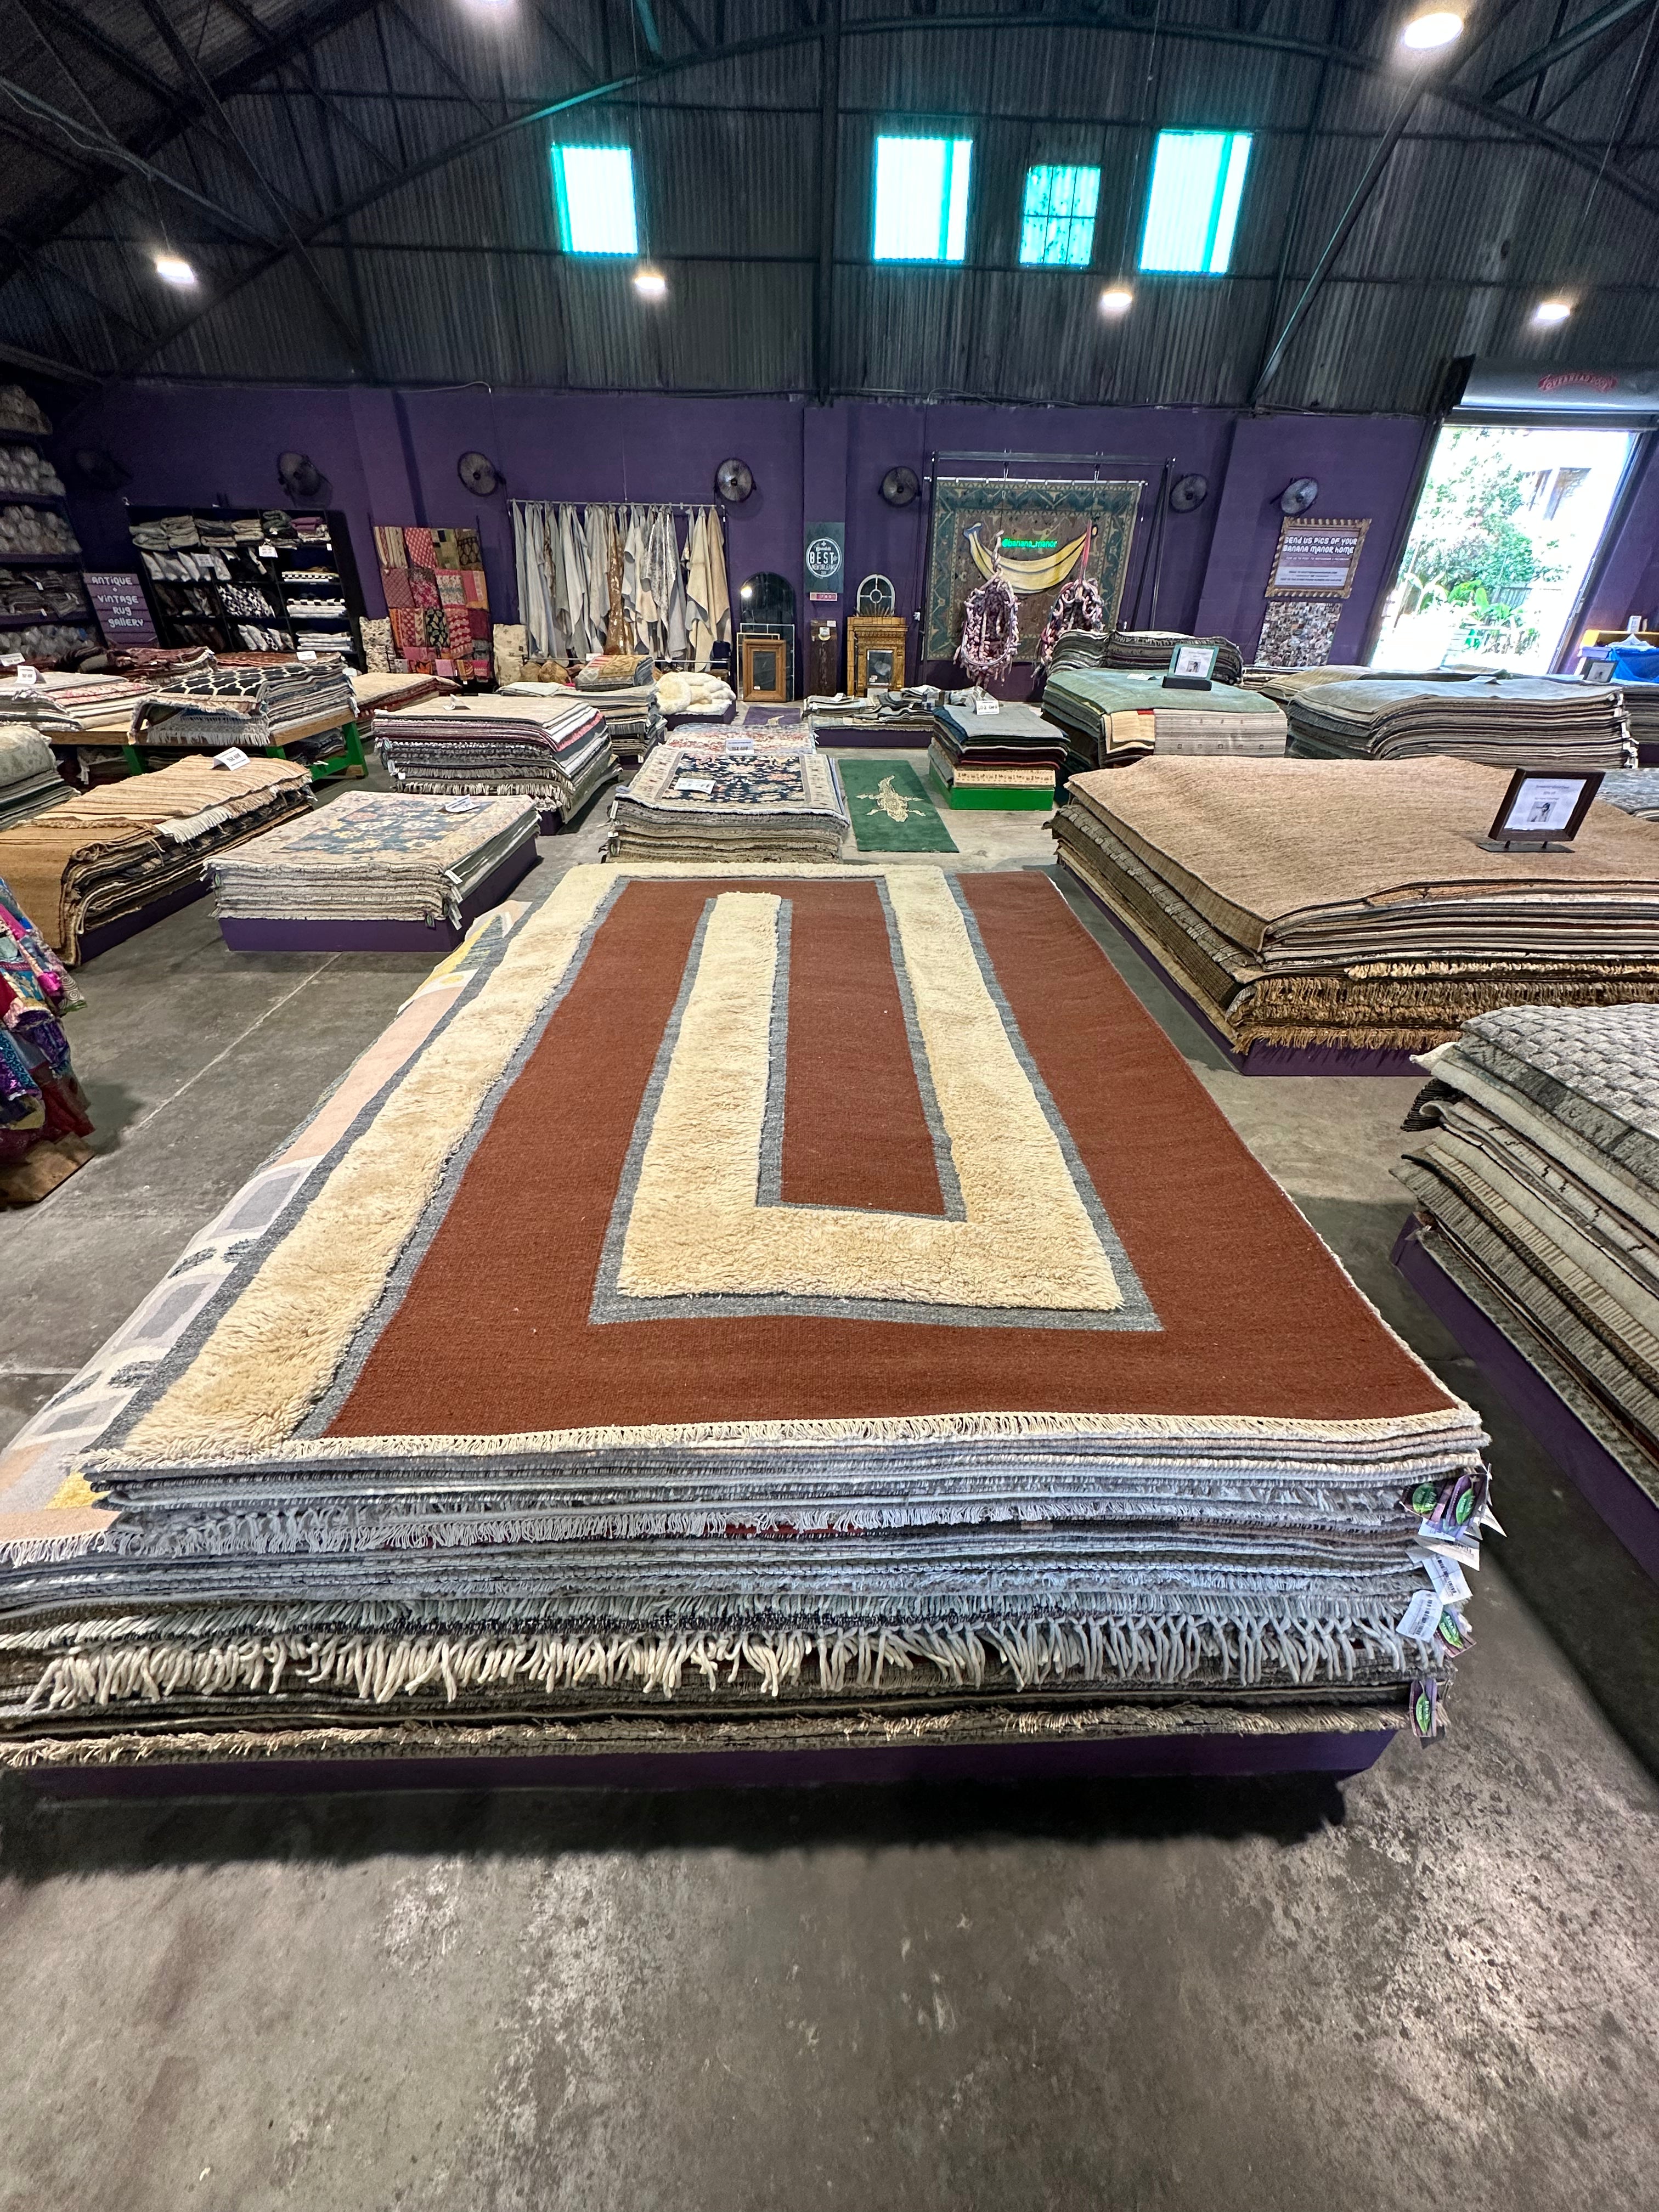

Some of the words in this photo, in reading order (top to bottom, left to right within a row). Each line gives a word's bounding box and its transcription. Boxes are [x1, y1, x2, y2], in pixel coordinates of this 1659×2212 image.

[1546, 373, 1590, 389] OVERHEAD
[1002, 539, 1058, 548] @banana_manor
[1310, 546, 1334, 554] MANOR
[1335, 546, 1355, 555] HOME
[810, 551, 834, 565] BEST
[92, 576, 132, 586] ANTIQUE
[97, 595, 139, 605] VINTAGE
[112, 606, 132, 616] RUG
[108, 617, 143, 628] GALLERY
